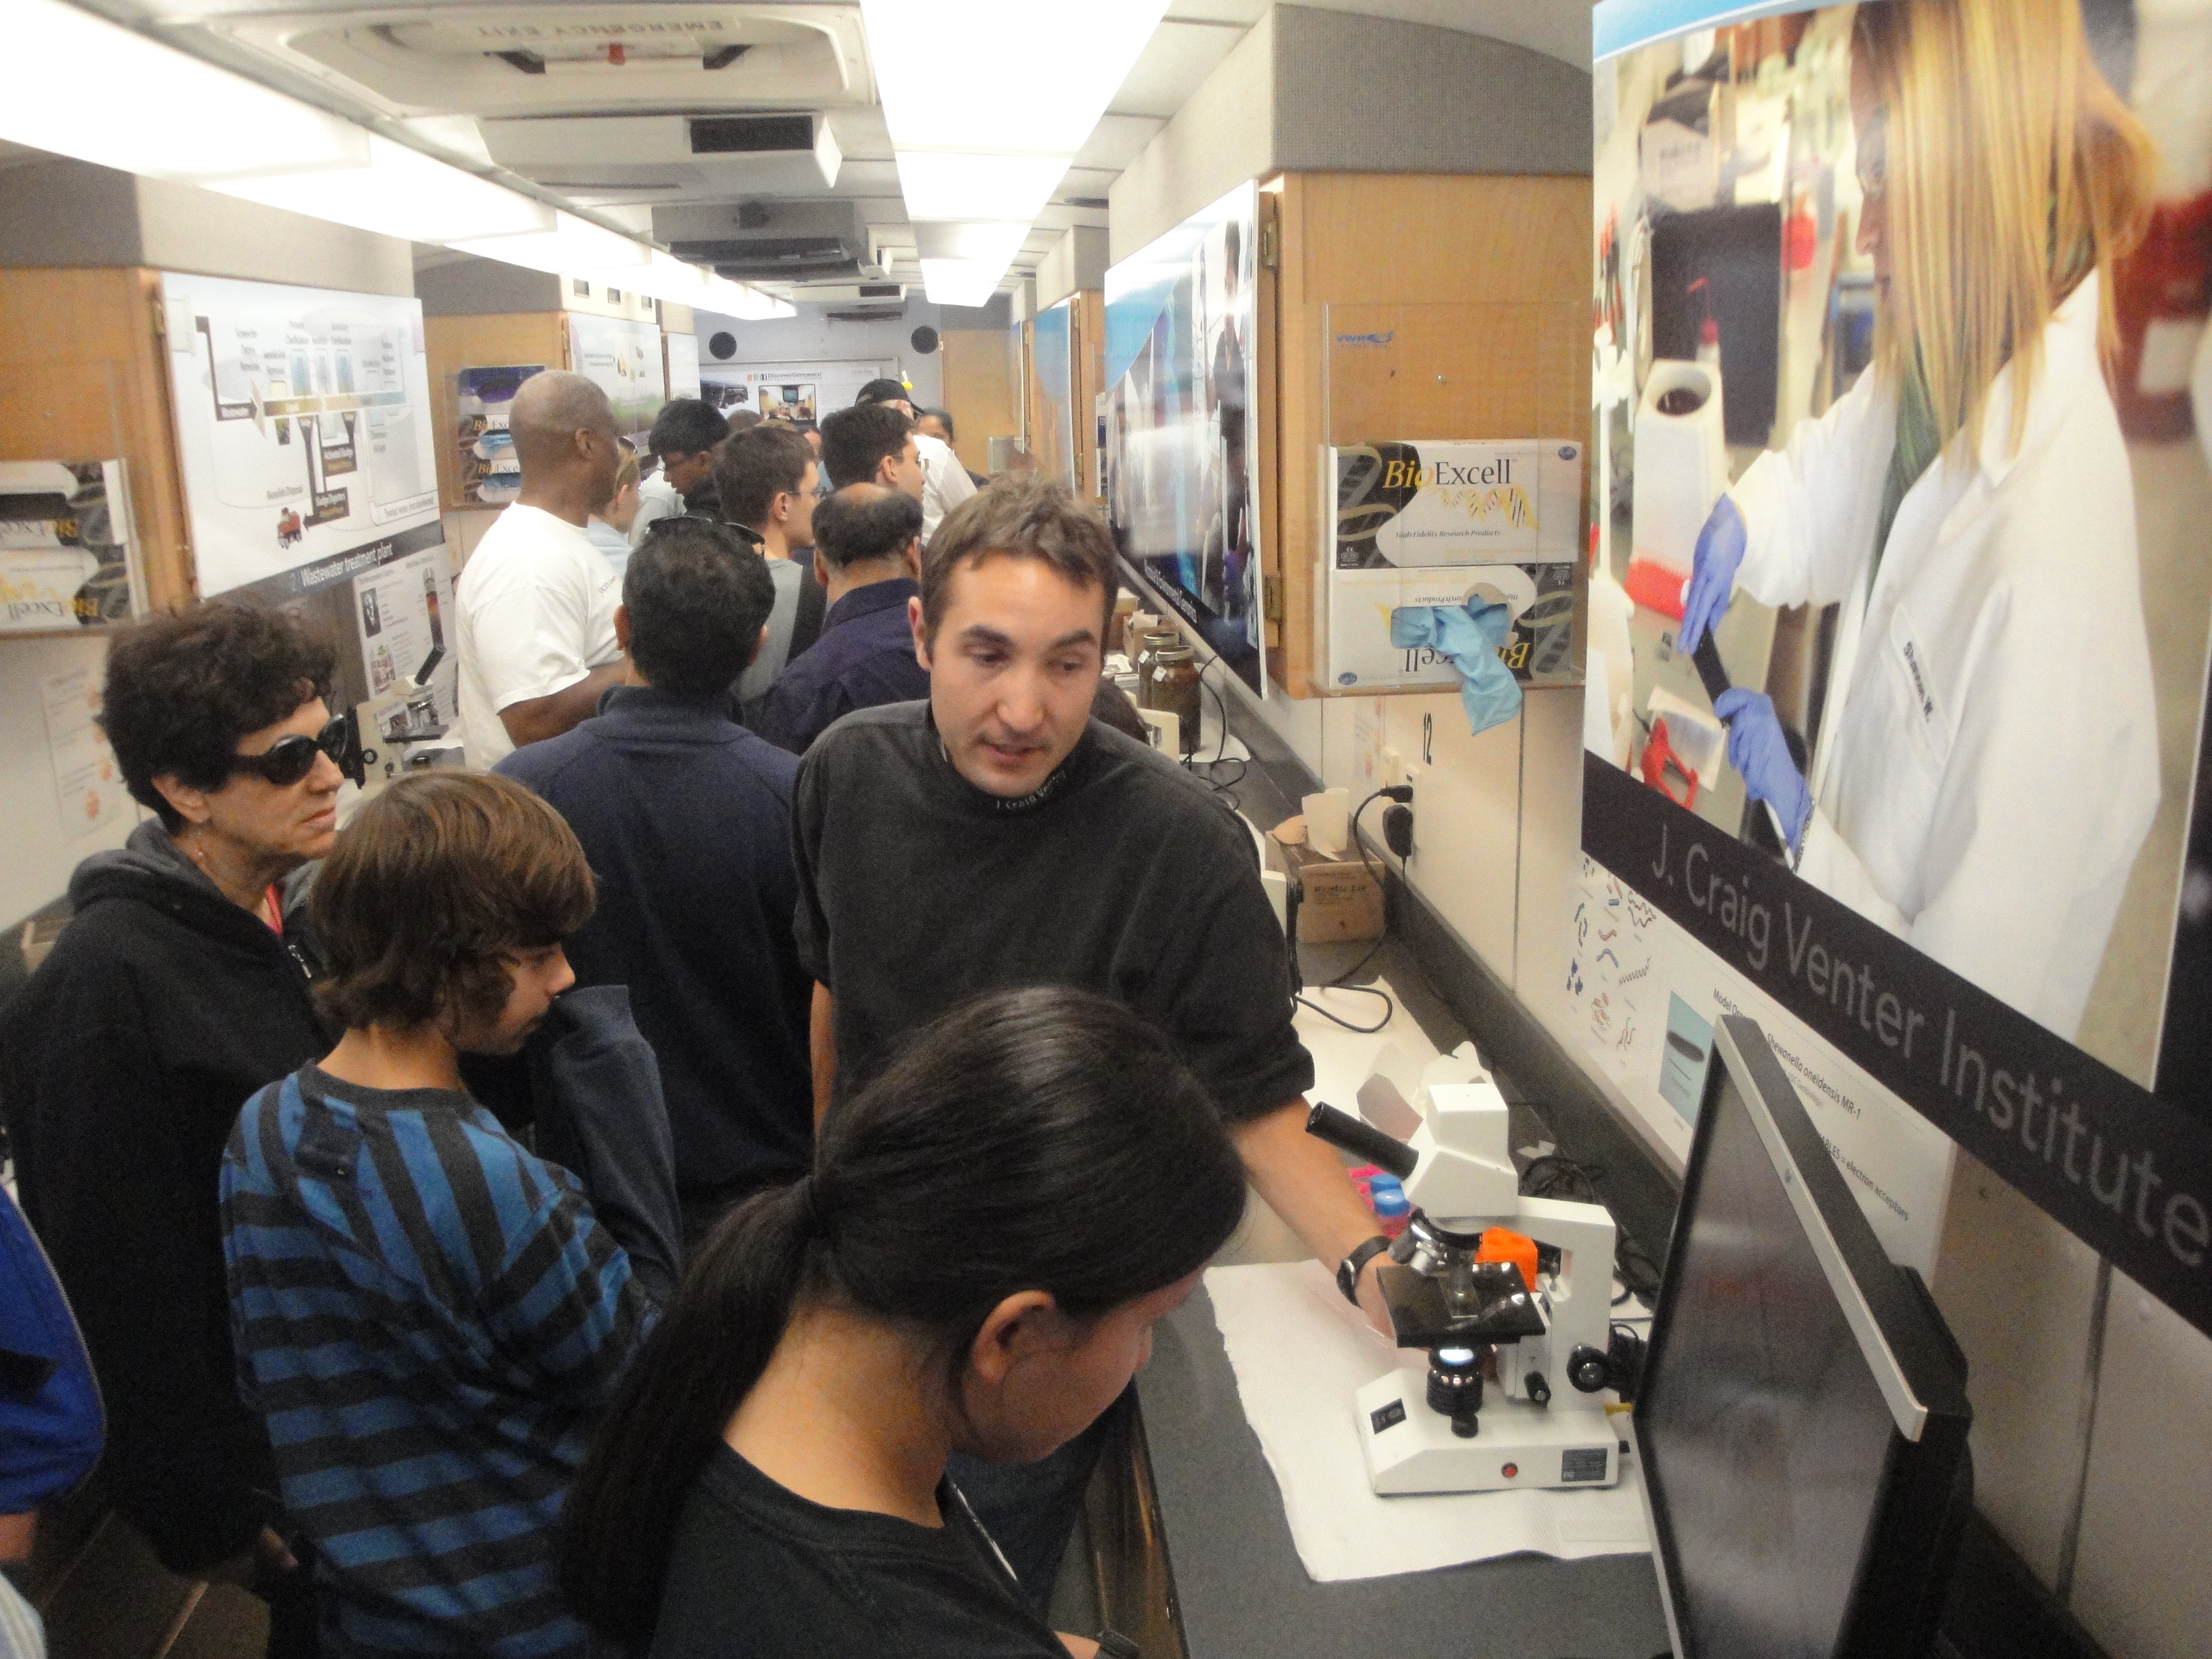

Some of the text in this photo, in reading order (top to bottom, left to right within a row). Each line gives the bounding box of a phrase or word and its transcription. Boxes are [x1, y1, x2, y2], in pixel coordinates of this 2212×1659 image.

[1413, 530, 1437, 539] Fidelity
[300, 562, 344, 586] Wastewater
[344, 548, 376, 571] treatment
[376, 542, 393, 565] plant
[1713, 988, 1732, 1012] Model
[1652, 823, 2211, 1265] J. Craig Venter Institute
[1766, 1033, 1861, 1120] Shewanella oneidensis MR-1
[1846, 1155, 1873, 1189] electron
[1875, 1187, 1909, 1222] acceptors
